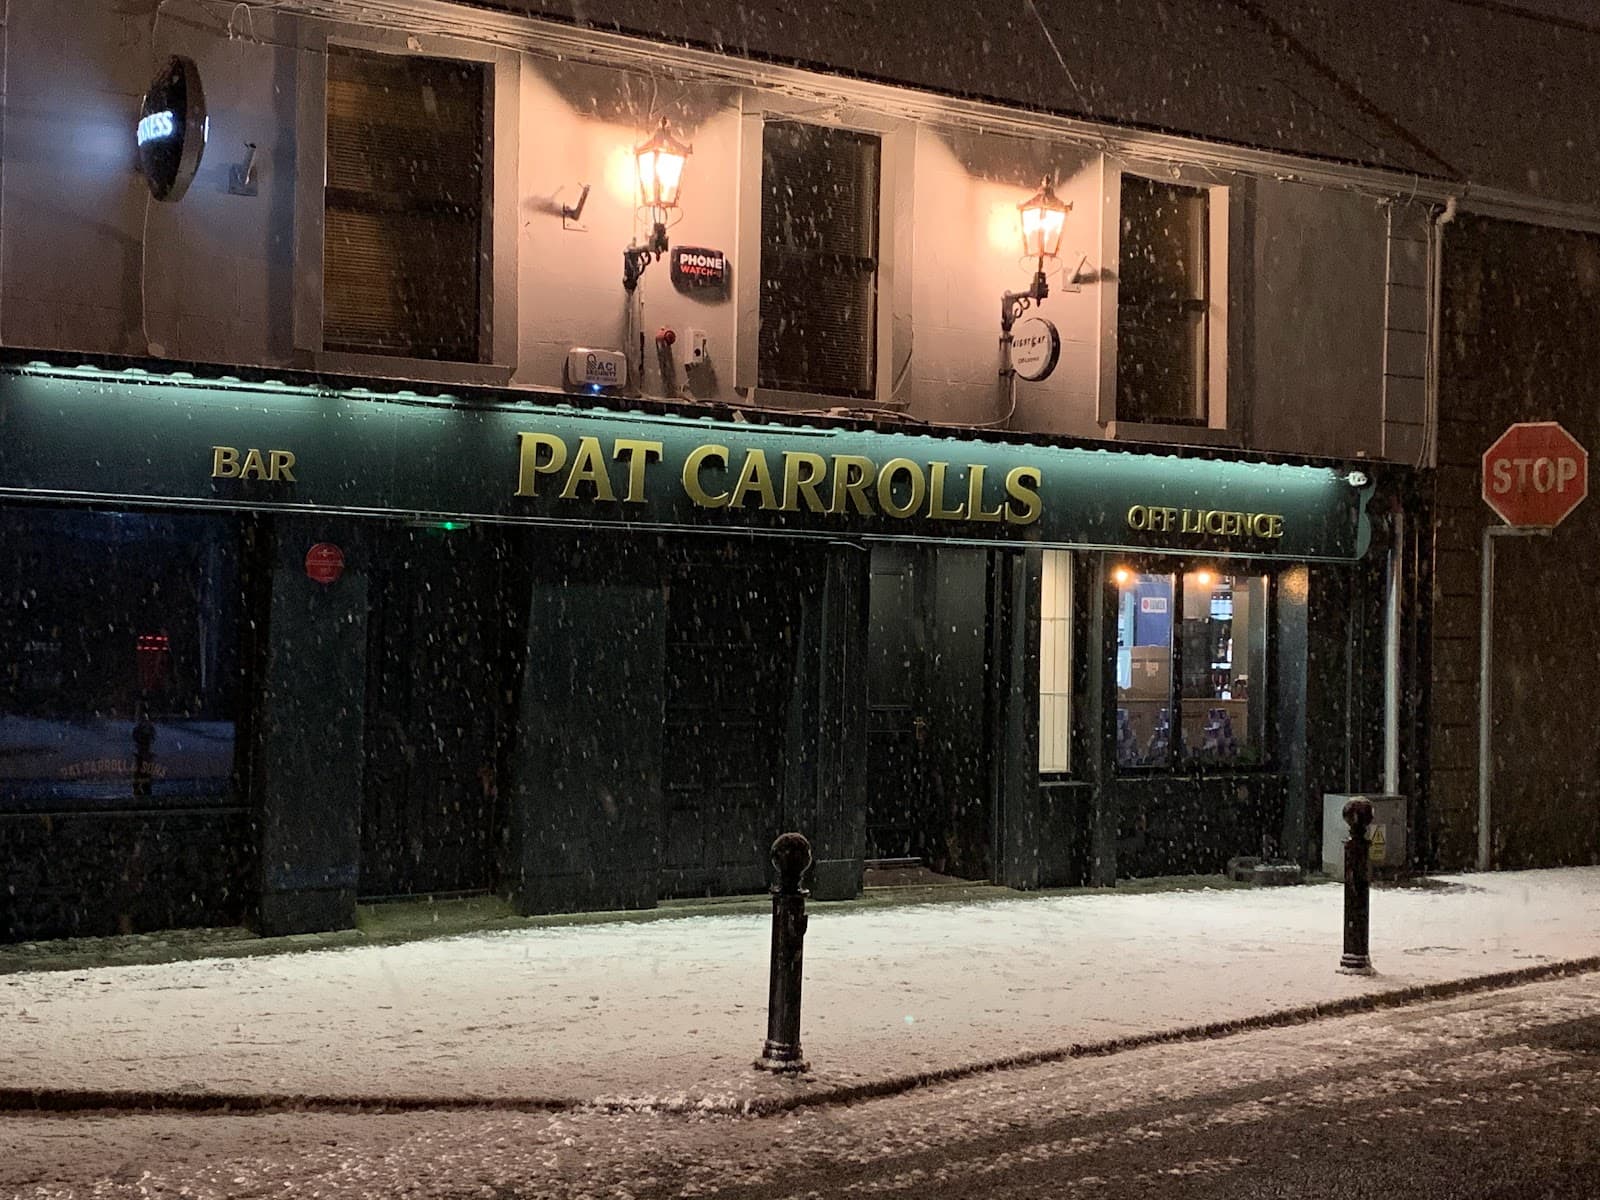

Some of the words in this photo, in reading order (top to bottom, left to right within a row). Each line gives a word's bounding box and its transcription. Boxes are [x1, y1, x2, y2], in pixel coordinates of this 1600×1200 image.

[680, 253, 722, 269] PHONE
[680, 265, 713, 276] WATCH
[211, 446, 297, 481] BAR
[513, 432, 663, 503] PAT
[682, 444, 1042, 525] CARROLLS
[1493, 457, 1577, 493] STOP
[1127, 505, 1178, 531] OFF
[1181, 509, 1284, 538] LICENCE
